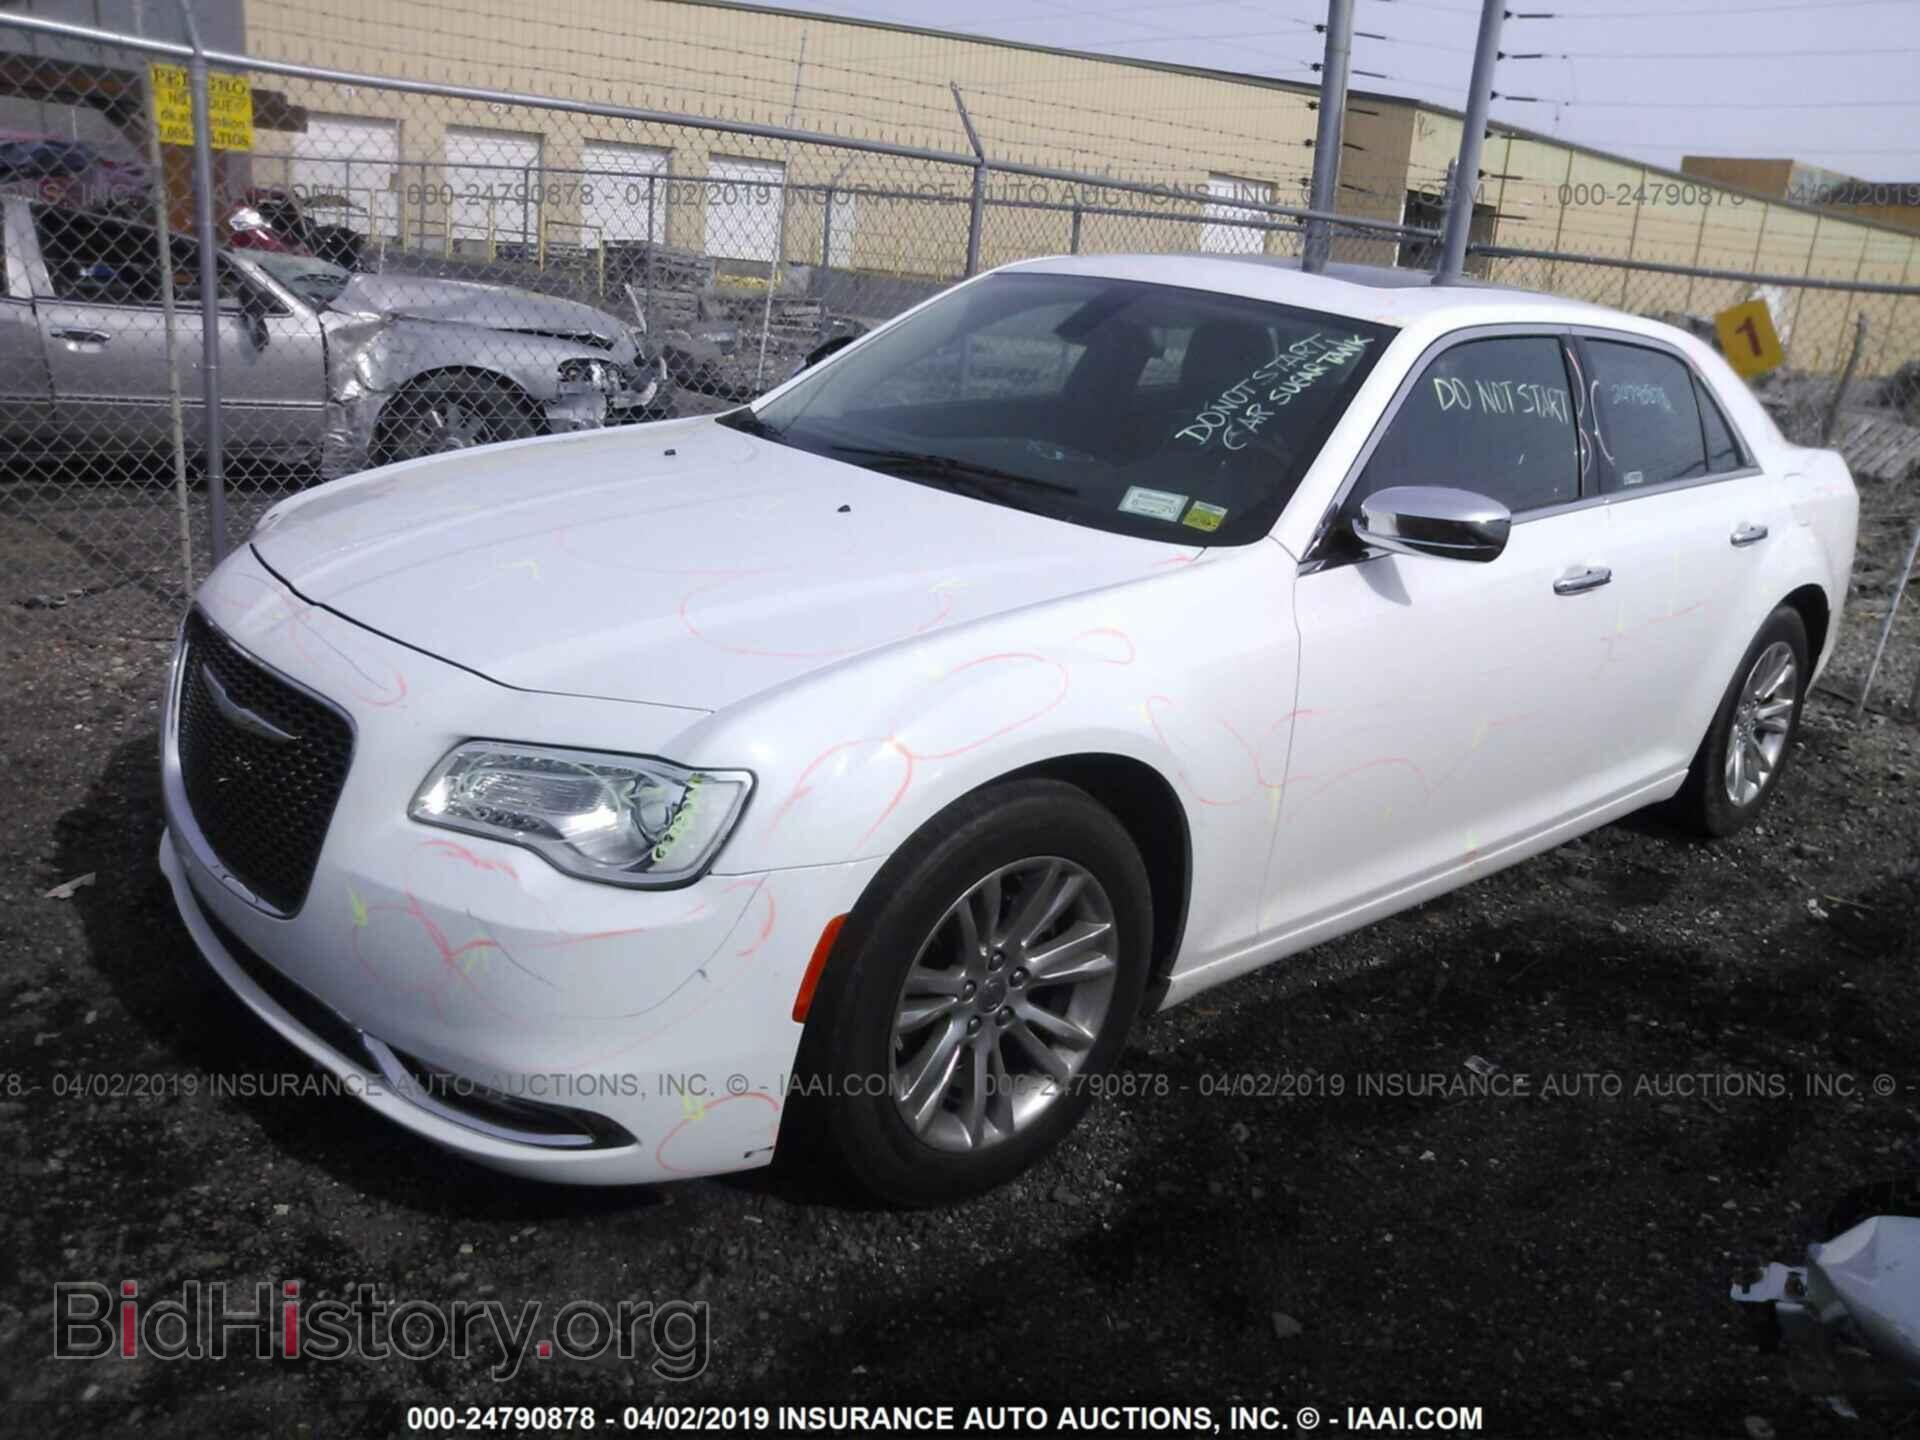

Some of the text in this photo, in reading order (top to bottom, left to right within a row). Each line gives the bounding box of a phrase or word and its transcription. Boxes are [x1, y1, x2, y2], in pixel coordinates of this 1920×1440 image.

[1735, 316, 1763, 357] 1
[1433, 377, 1569, 425] DO NOT START
[1223, 402, 1276, 450] CAR
